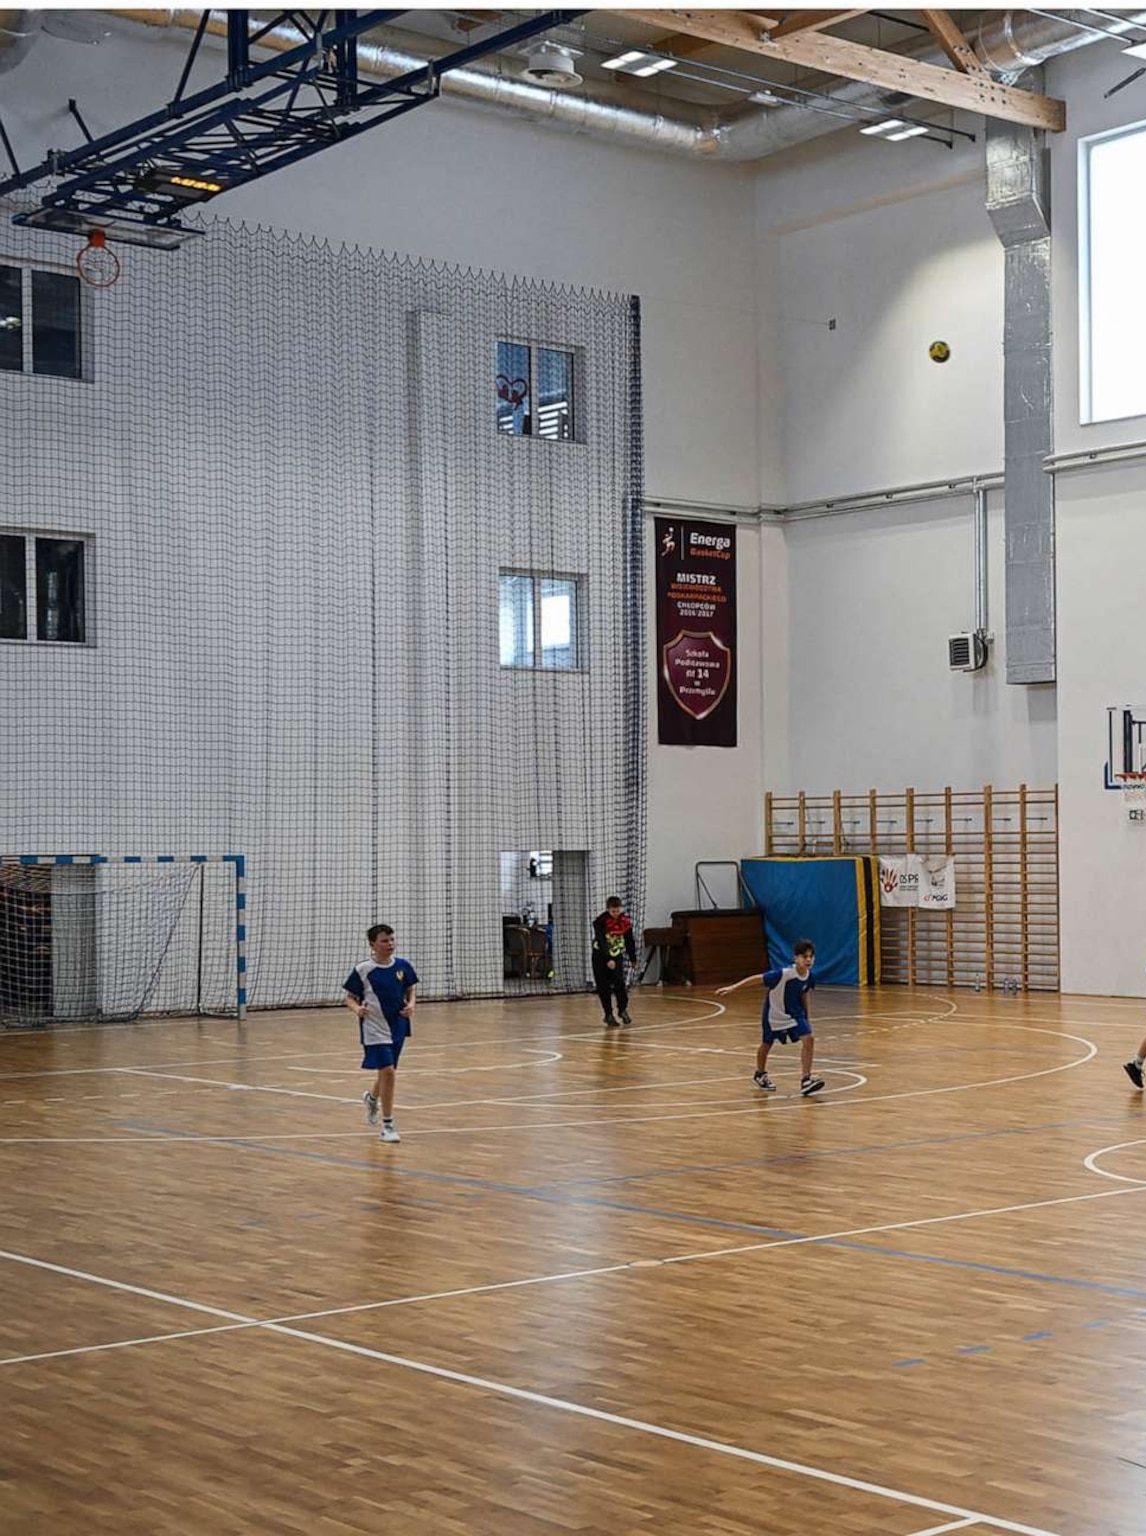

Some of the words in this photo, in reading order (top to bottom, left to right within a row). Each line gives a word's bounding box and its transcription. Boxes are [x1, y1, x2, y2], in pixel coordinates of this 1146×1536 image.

[690, 532, 731, 550] Energa
[676, 572, 716, 585] MISTRZ
[697, 668, 710, 678] 14
